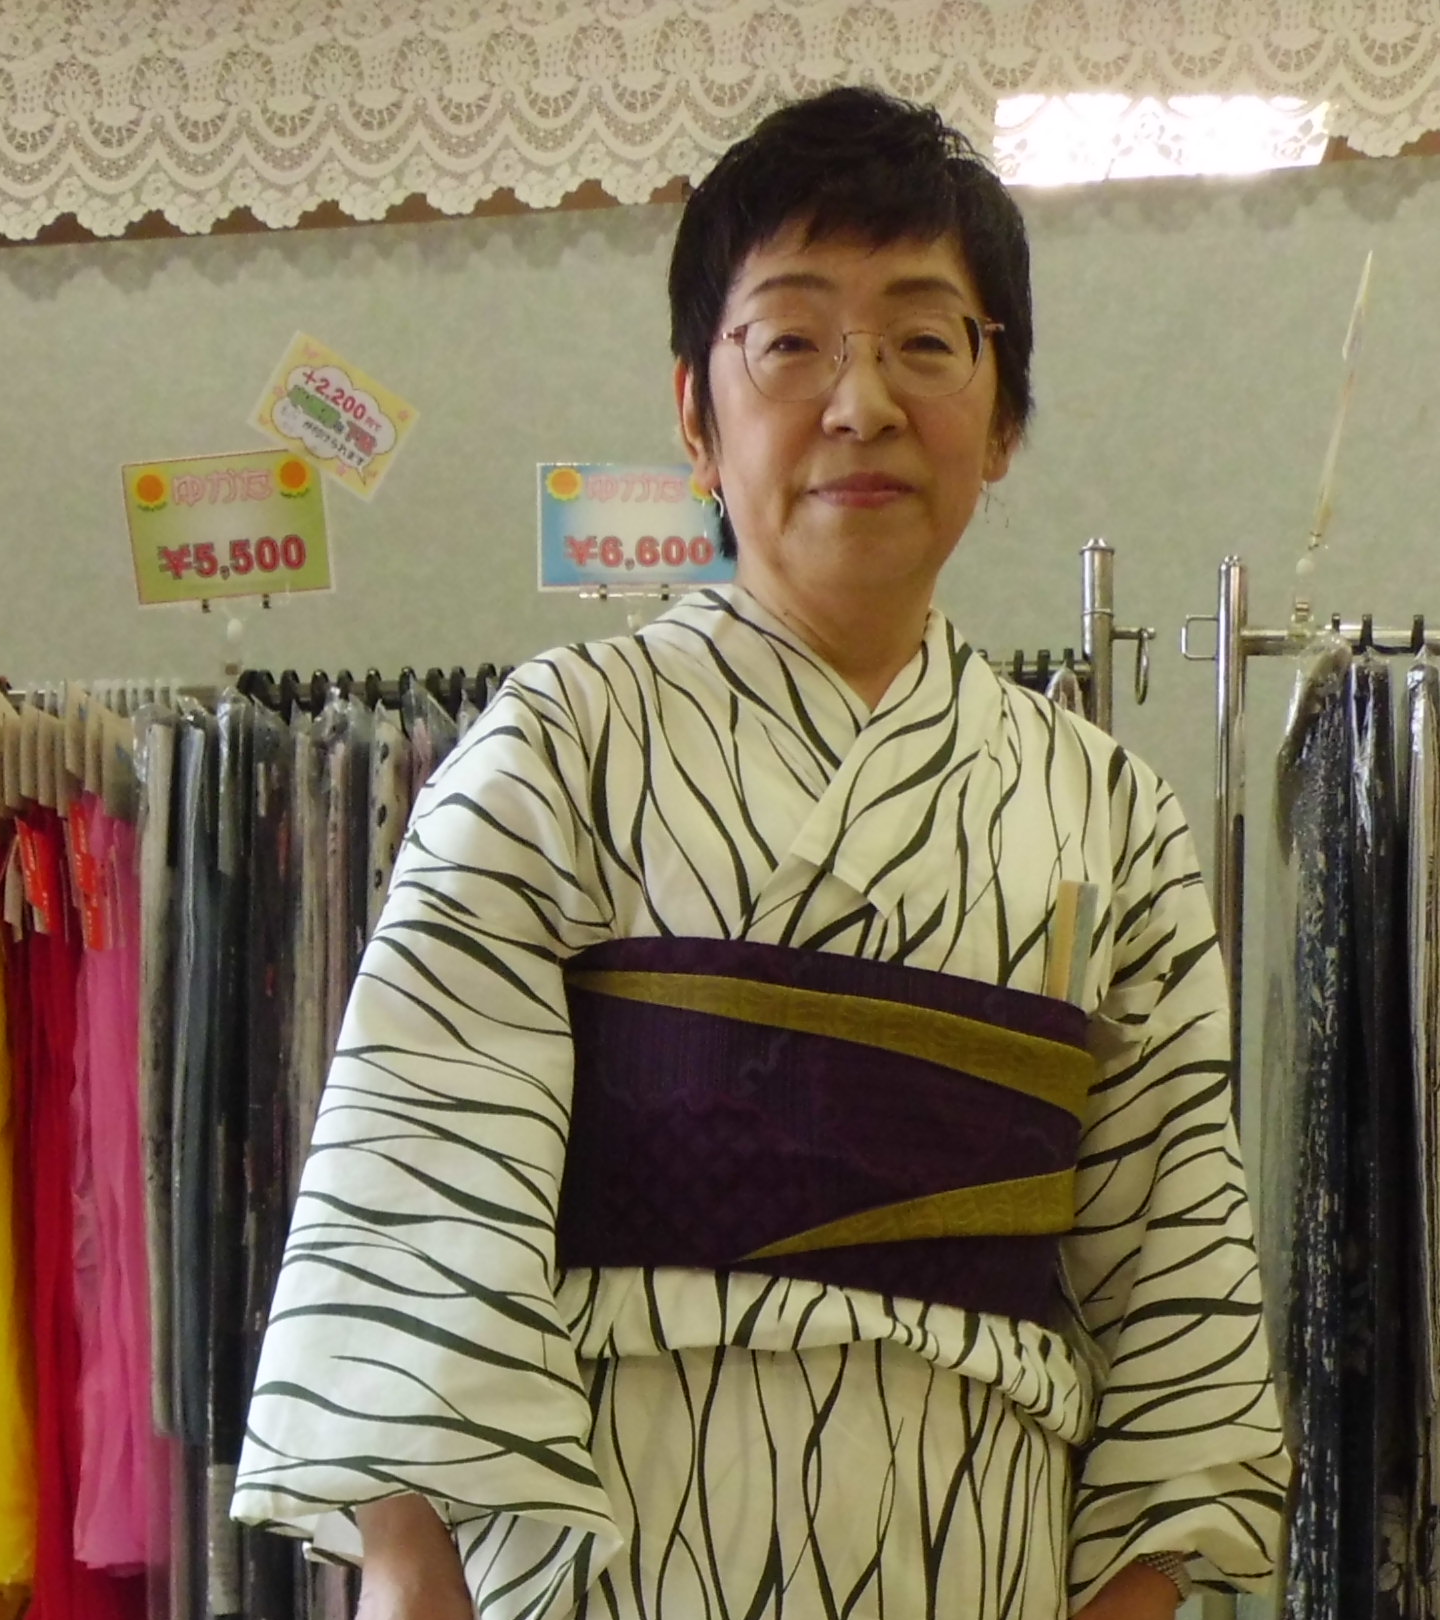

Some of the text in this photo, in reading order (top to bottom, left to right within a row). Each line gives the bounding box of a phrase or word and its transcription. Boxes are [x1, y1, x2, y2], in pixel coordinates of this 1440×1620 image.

[171, 466, 274, 508] ゆかた
[585, 472, 688, 504] ゆかた
[157, 532, 308, 581] ¥5,500
[563, 534, 716, 572] ¥6,600
